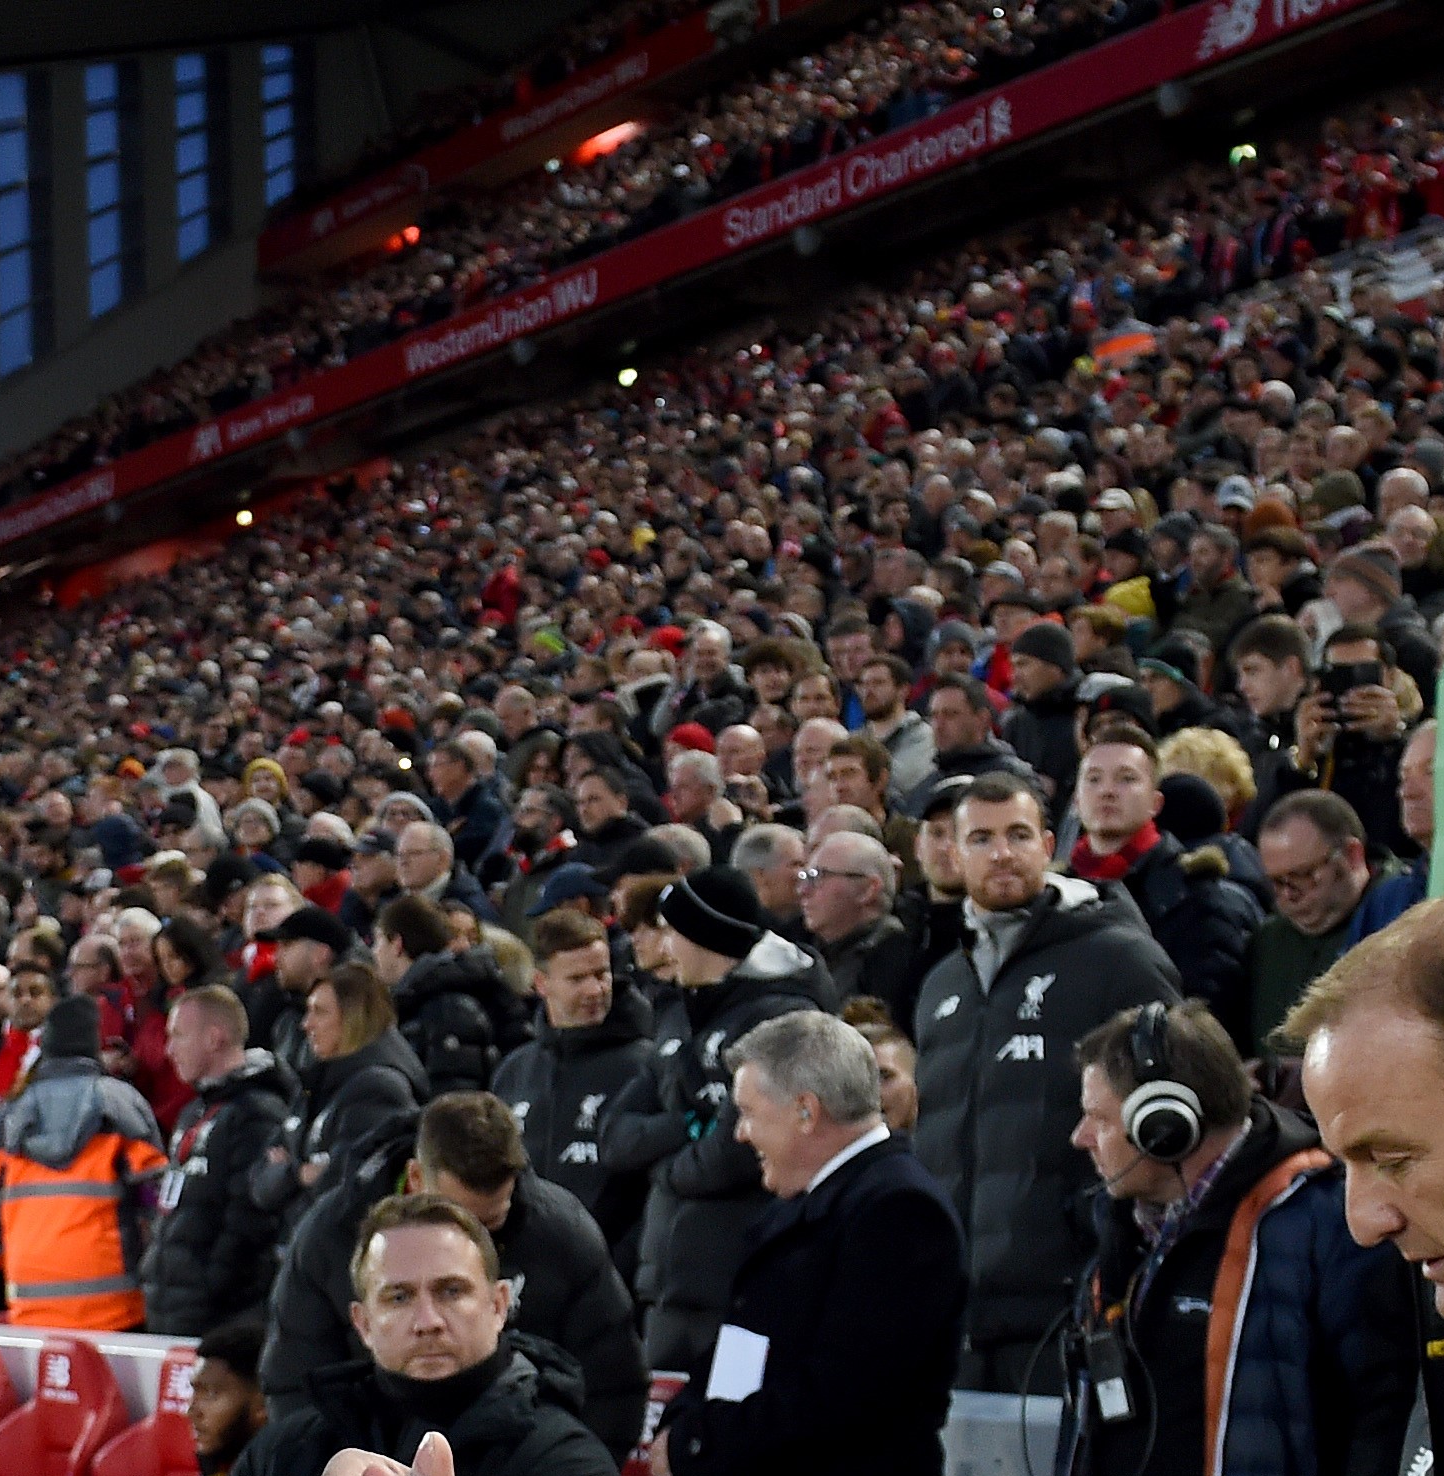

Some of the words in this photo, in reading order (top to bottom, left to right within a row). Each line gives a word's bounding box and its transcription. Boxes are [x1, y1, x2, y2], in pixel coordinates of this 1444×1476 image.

[724, 166, 842, 247] Standard
[844, 107, 987, 197] Chartered
[405, 306, 553, 375] WesternUnion
